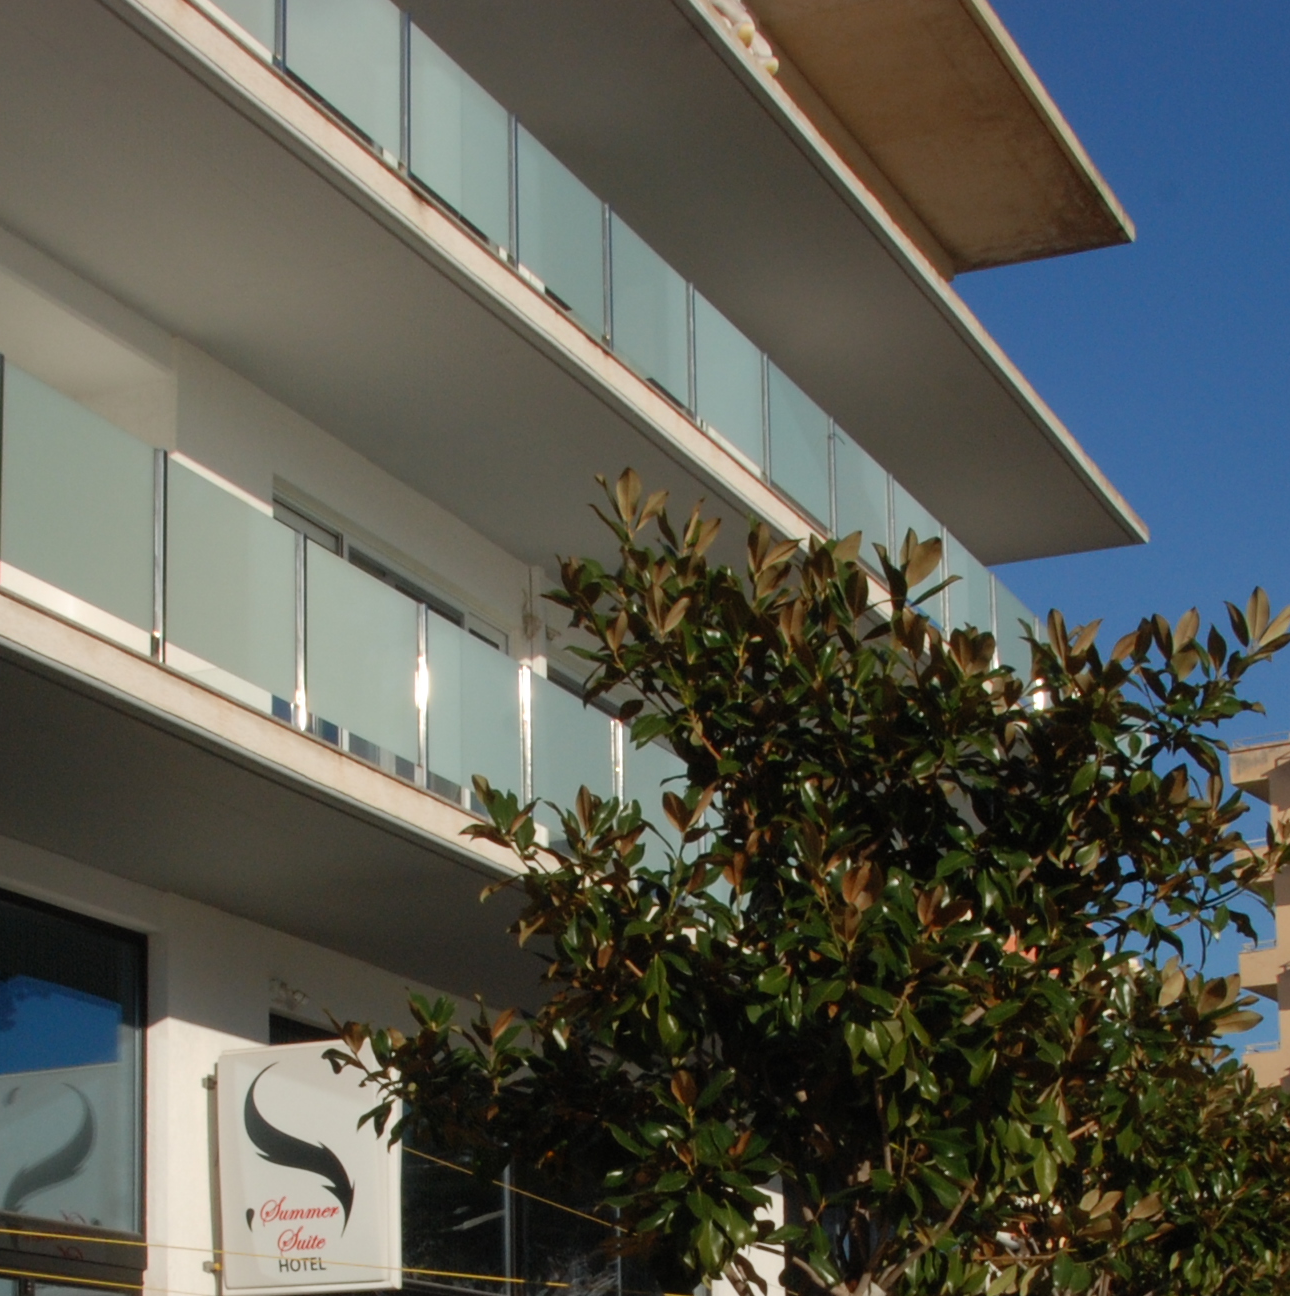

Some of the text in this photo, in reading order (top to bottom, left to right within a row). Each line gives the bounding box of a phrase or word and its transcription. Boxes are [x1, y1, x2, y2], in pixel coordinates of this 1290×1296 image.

[260, 1196, 340, 1227] Summer
[278, 1226, 326, 1257] Suite
[279, 1257, 327, 1273] HOTEL
